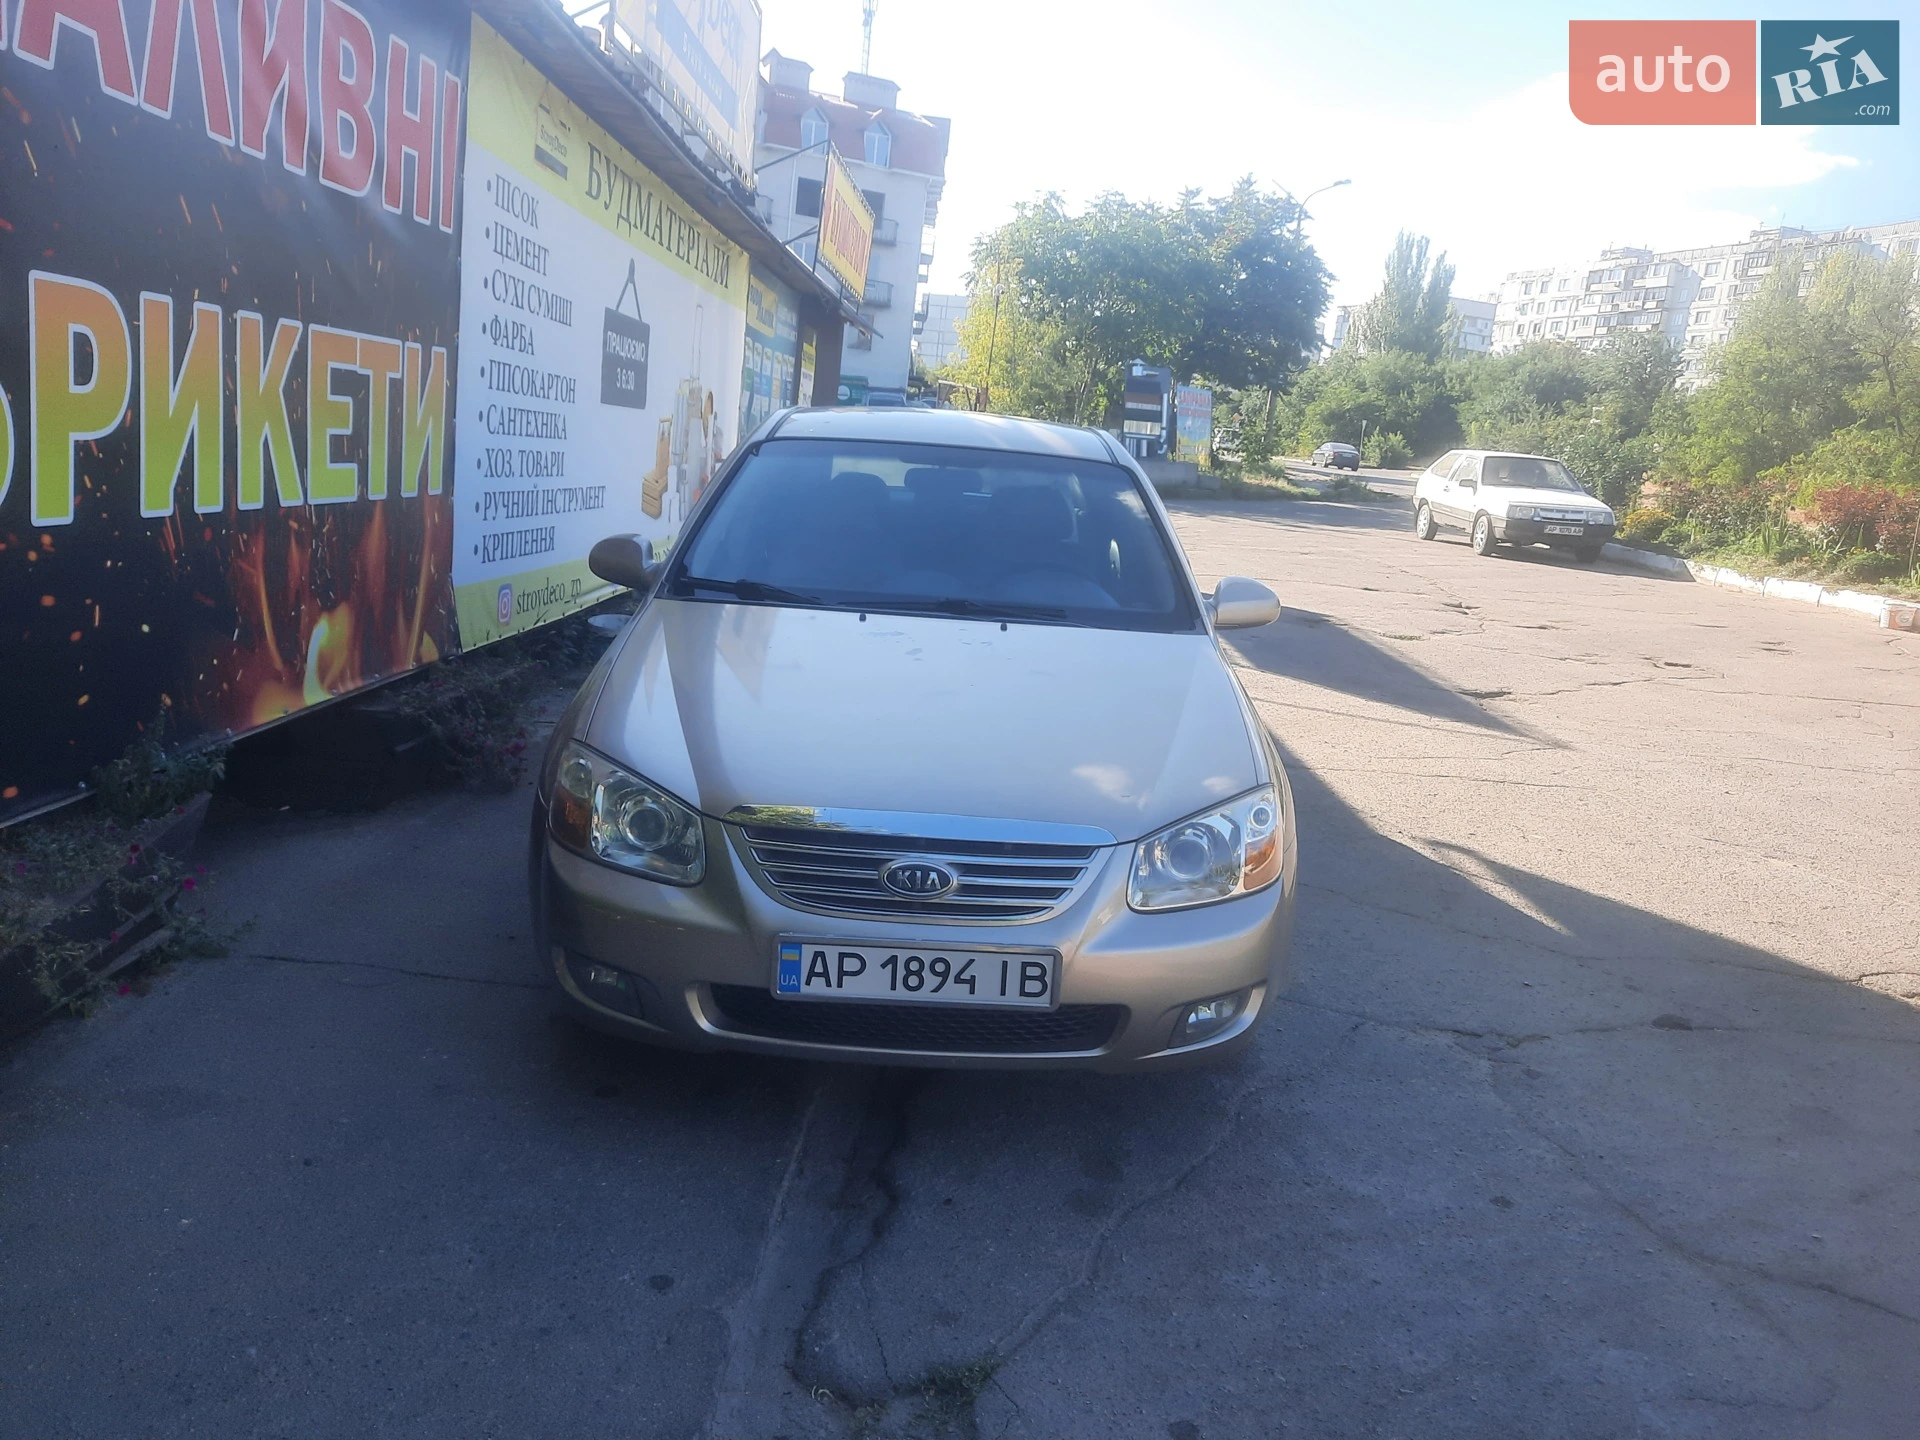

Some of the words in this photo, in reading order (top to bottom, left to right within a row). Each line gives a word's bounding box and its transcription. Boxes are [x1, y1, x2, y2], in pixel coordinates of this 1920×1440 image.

[0, 0, 461, 234] ЛИВНІ
[494, 173, 539, 230] ПІСОК
[585, 141, 730, 289] БУДМАТЕРІАЛИ
[493, 220, 550, 277] ЦЕМЕНТ
[492, 268, 525, 310] СУХІ
[527, 283, 572, 327] СУМІШІ
[490, 314, 535, 356] ФАРБА
[606, 330, 646, 362] ПРАЦЮЄМО
[0, 268, 447, 528] РИКЕТИ
[487, 359, 576, 404] ГІПСОКАРТОН
[486, 403, 567, 440] САНТЕХНІКА
[484, 447, 515, 478] ХОЗ.
[518, 449, 565, 478] ТОВАРИ
[482, 483, 540, 521] РУЧНИЙ
[541, 485, 606, 516] ІНСТРУМЕНТ
[481, 525, 556, 564] КРІПЛЕННЯ
[516, 577, 582, 618] stroydeco_zp
[897, 869, 942, 889] KIA
[780, 974, 798, 987] UA
[805, 950, 867, 989] AP
[880, 954, 976, 995] 1894
[1000, 960, 1049, 998] IB
